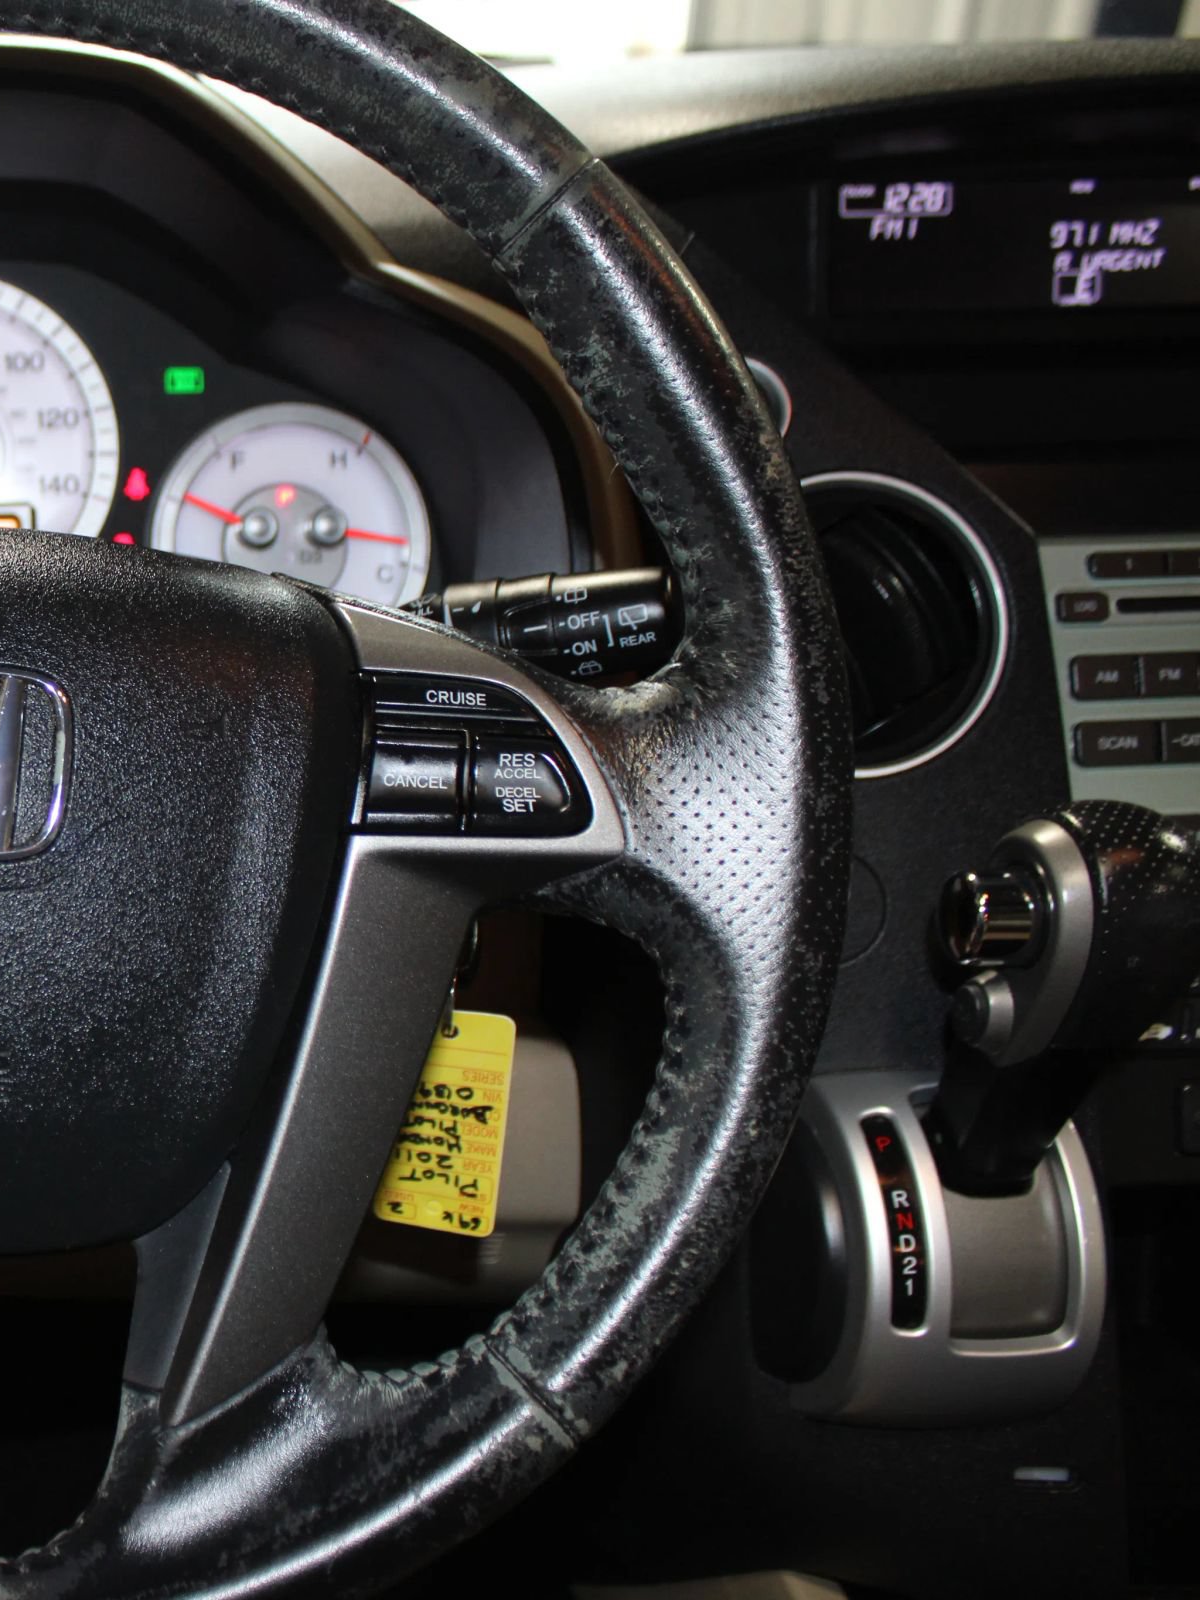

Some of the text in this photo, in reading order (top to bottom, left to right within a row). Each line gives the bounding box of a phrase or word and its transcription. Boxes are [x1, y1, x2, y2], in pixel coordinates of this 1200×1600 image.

[4, 352, 45, 374] 100
[37, 407, 80, 430] 120
[330, 452, 348, 469] H
[38, 474, 81, 498] 140
[567, 611, 600, 630] OFF
[571, 639, 597, 656] ON
[619, 631, 656, 648] REAR
[1095, 671, 1120, 684] AM
[1158, 668, 1183, 682] FM
[426, 689, 487, 707] CRUISE
[1097, 736, 1139, 750] SCAN
[499, 753, 536, 768] RES
[494, 767, 542, 779] ACCEL
[383, 774, 448, 790] CANCEL
[495, 786, 541, 799] DECEL
[502, 799, 536, 813] SET
[462, 1070, 504, 1085] SERIES
[482, 1091, 502, 1102] VIN
[875, 1136, 891, 1151] P
[463, 1159, 494, 1175] YEAR
[397, 1168, 479, 1198] PILOT
[891, 1190, 910, 1208] R
[896, 1213, 914, 1230] N
[899, 1234, 916, 1253] D
[902, 1257, 917, 1275] 2
[904, 1278, 914, 1296] 1
